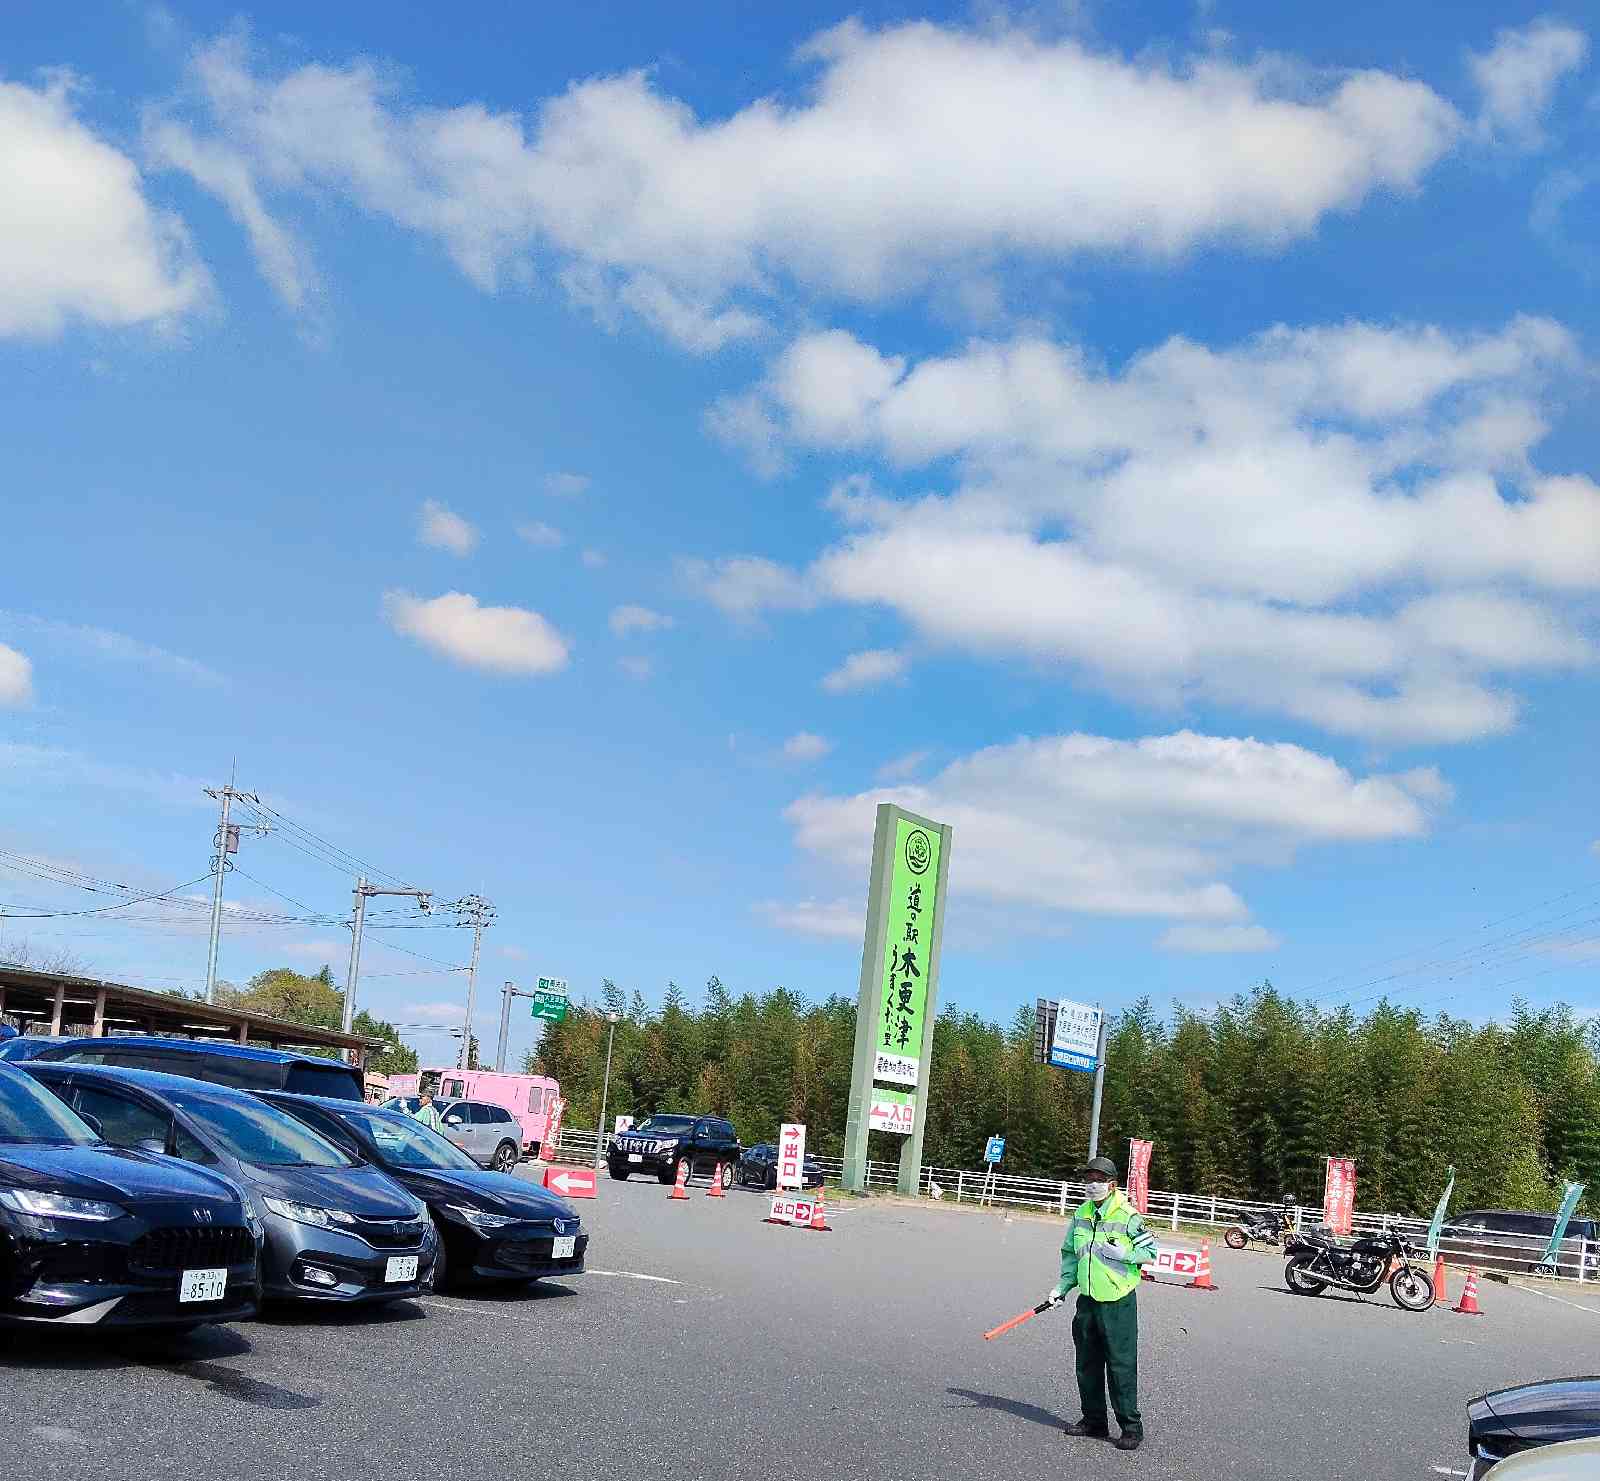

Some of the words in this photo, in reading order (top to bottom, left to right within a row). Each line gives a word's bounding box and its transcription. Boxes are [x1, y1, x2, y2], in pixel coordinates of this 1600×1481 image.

[896, 946, 921, 1050] 木更津
[890, 1104, 913, 1122] 入口
[783, 1143, 798, 1177] 出口
[773, 1201, 795, 1215] 出口
[190, 1281, 223, 1299] 85-10
